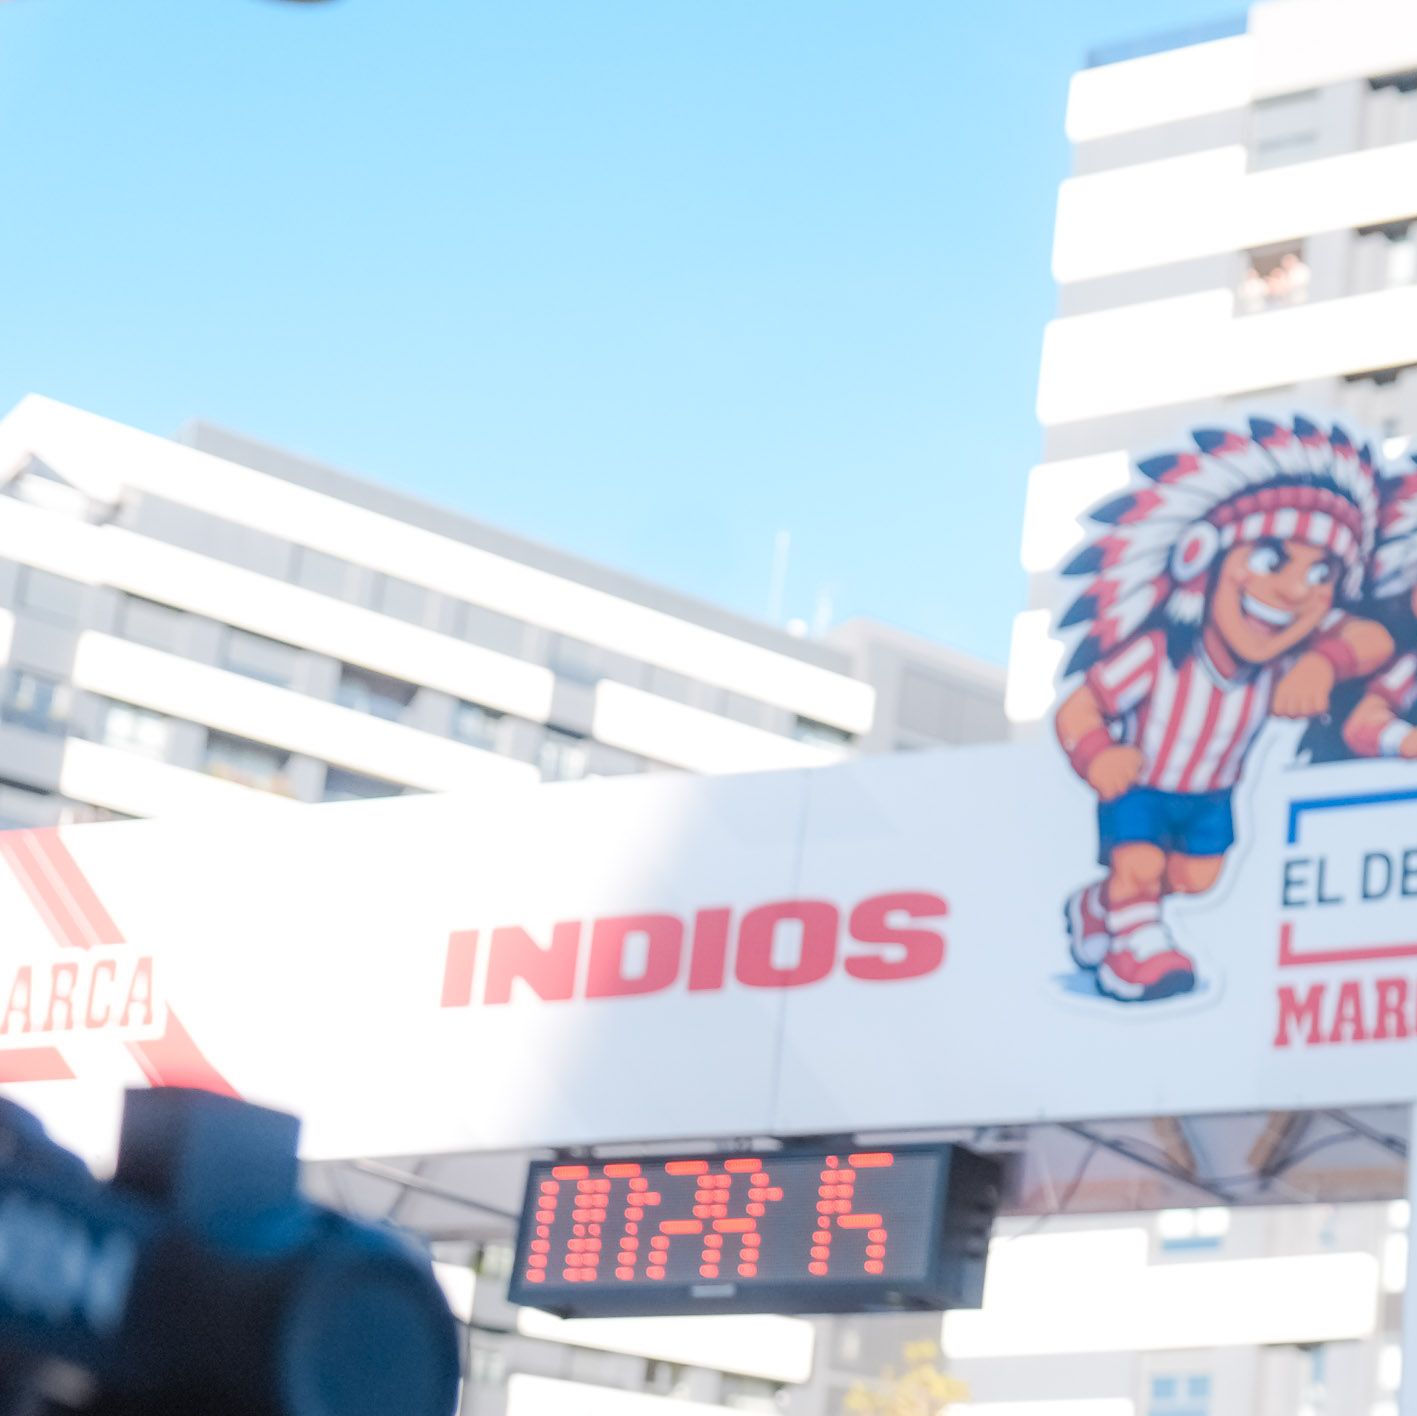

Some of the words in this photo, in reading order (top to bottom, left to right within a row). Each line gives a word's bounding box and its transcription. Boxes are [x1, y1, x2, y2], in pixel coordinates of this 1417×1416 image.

[1280, 856, 1343, 908] EL
[440, 890, 949, 1008] INDIOS
[0, 956, 154, 1036] ARCA
